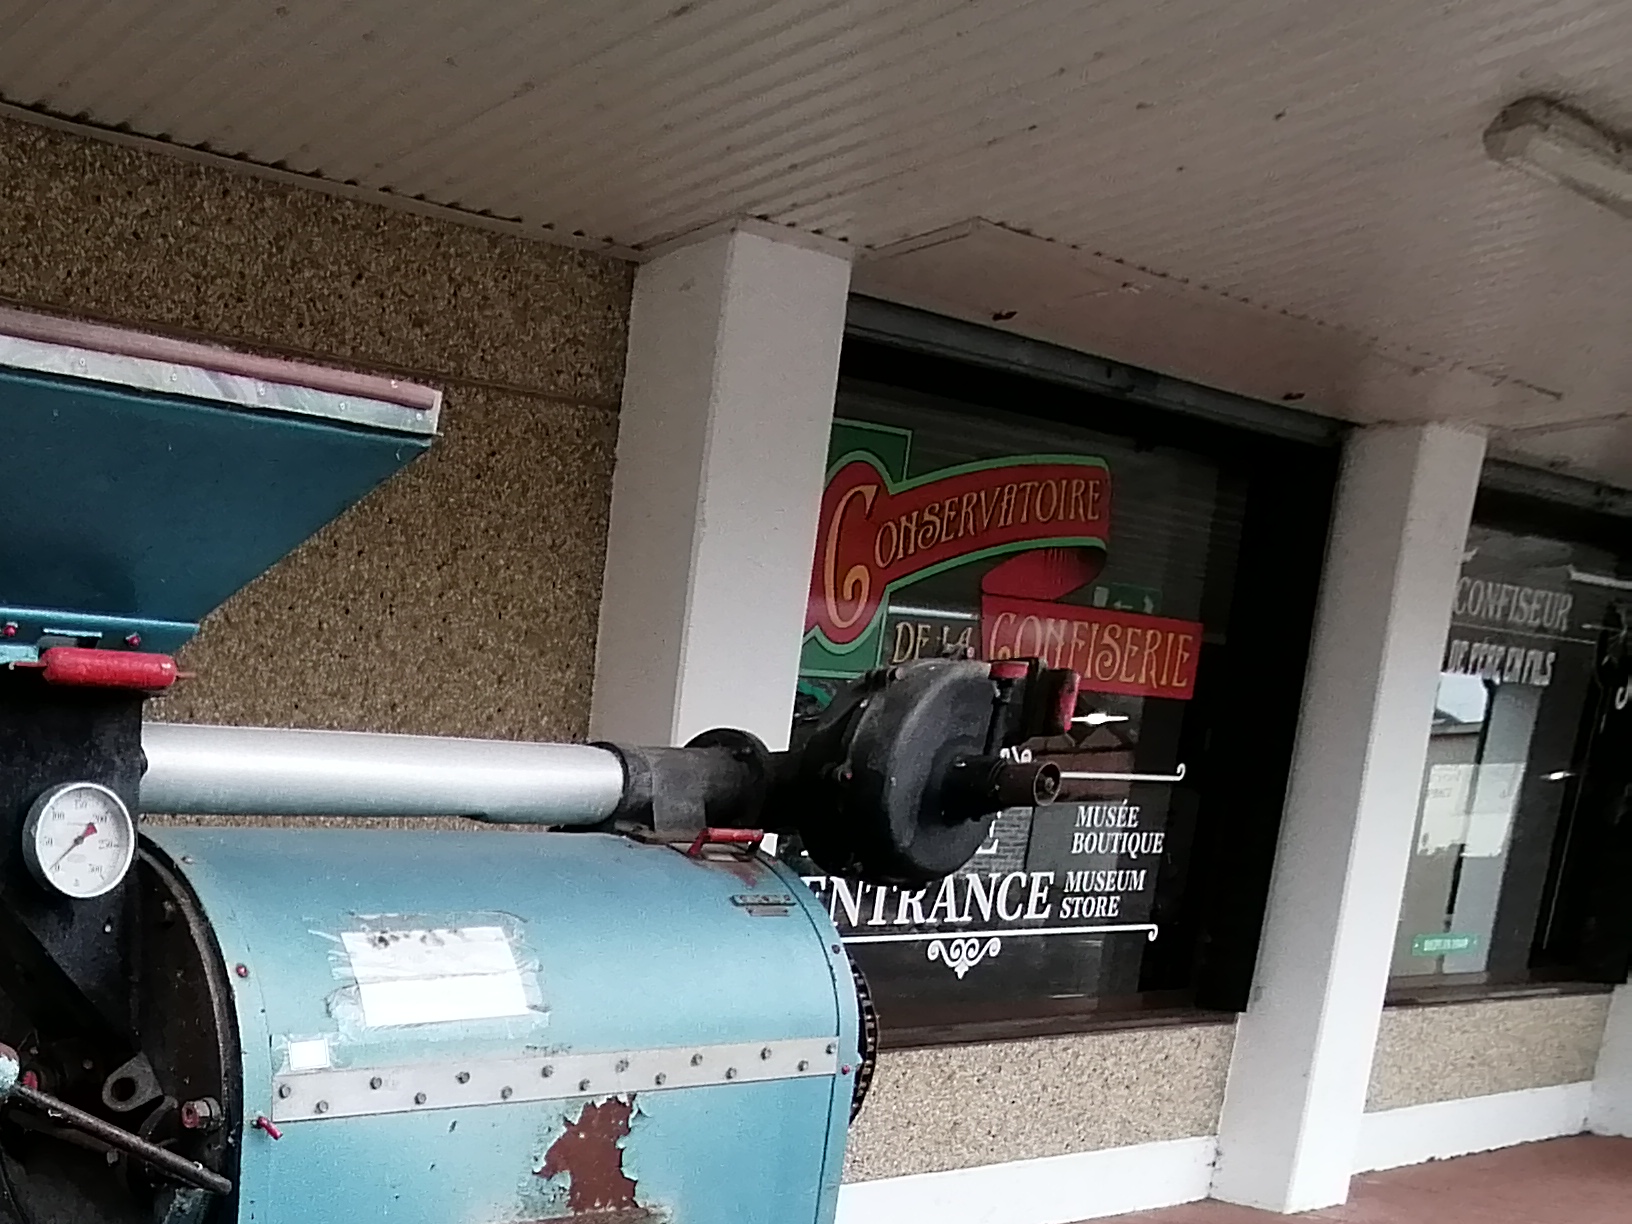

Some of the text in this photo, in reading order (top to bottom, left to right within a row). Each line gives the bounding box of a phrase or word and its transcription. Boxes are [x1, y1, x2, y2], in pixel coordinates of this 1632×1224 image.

[1453, 576, 1574, 632] CONFISEUR
[1075, 799, 1140, 828] MUSÉE
[1071, 832, 1165, 859] BOUTIQUE
[1063, 870, 1146, 893] MUSEUM
[1059, 896, 1120, 919] STORE
